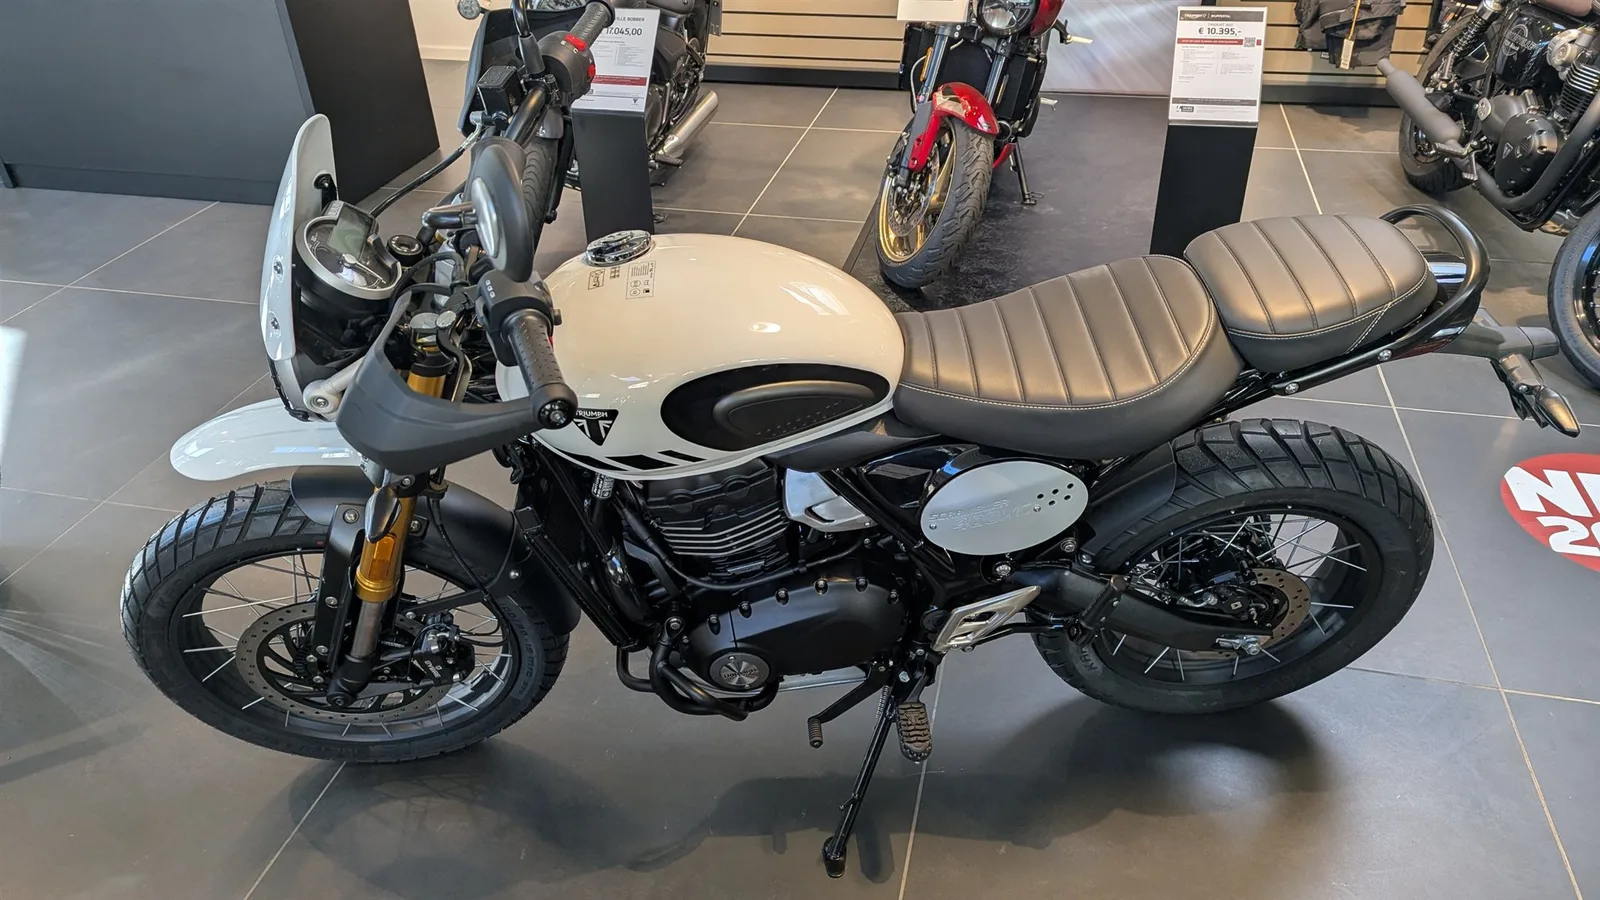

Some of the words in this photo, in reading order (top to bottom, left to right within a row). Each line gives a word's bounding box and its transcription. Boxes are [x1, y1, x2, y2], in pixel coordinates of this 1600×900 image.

[606, 27, 642, 36] 17.045,00
[1198, 27, 1204, 35] €
[1207, 27, 1242, 36] 10.395,-
[576, 410, 608, 418] TRIUMPH
